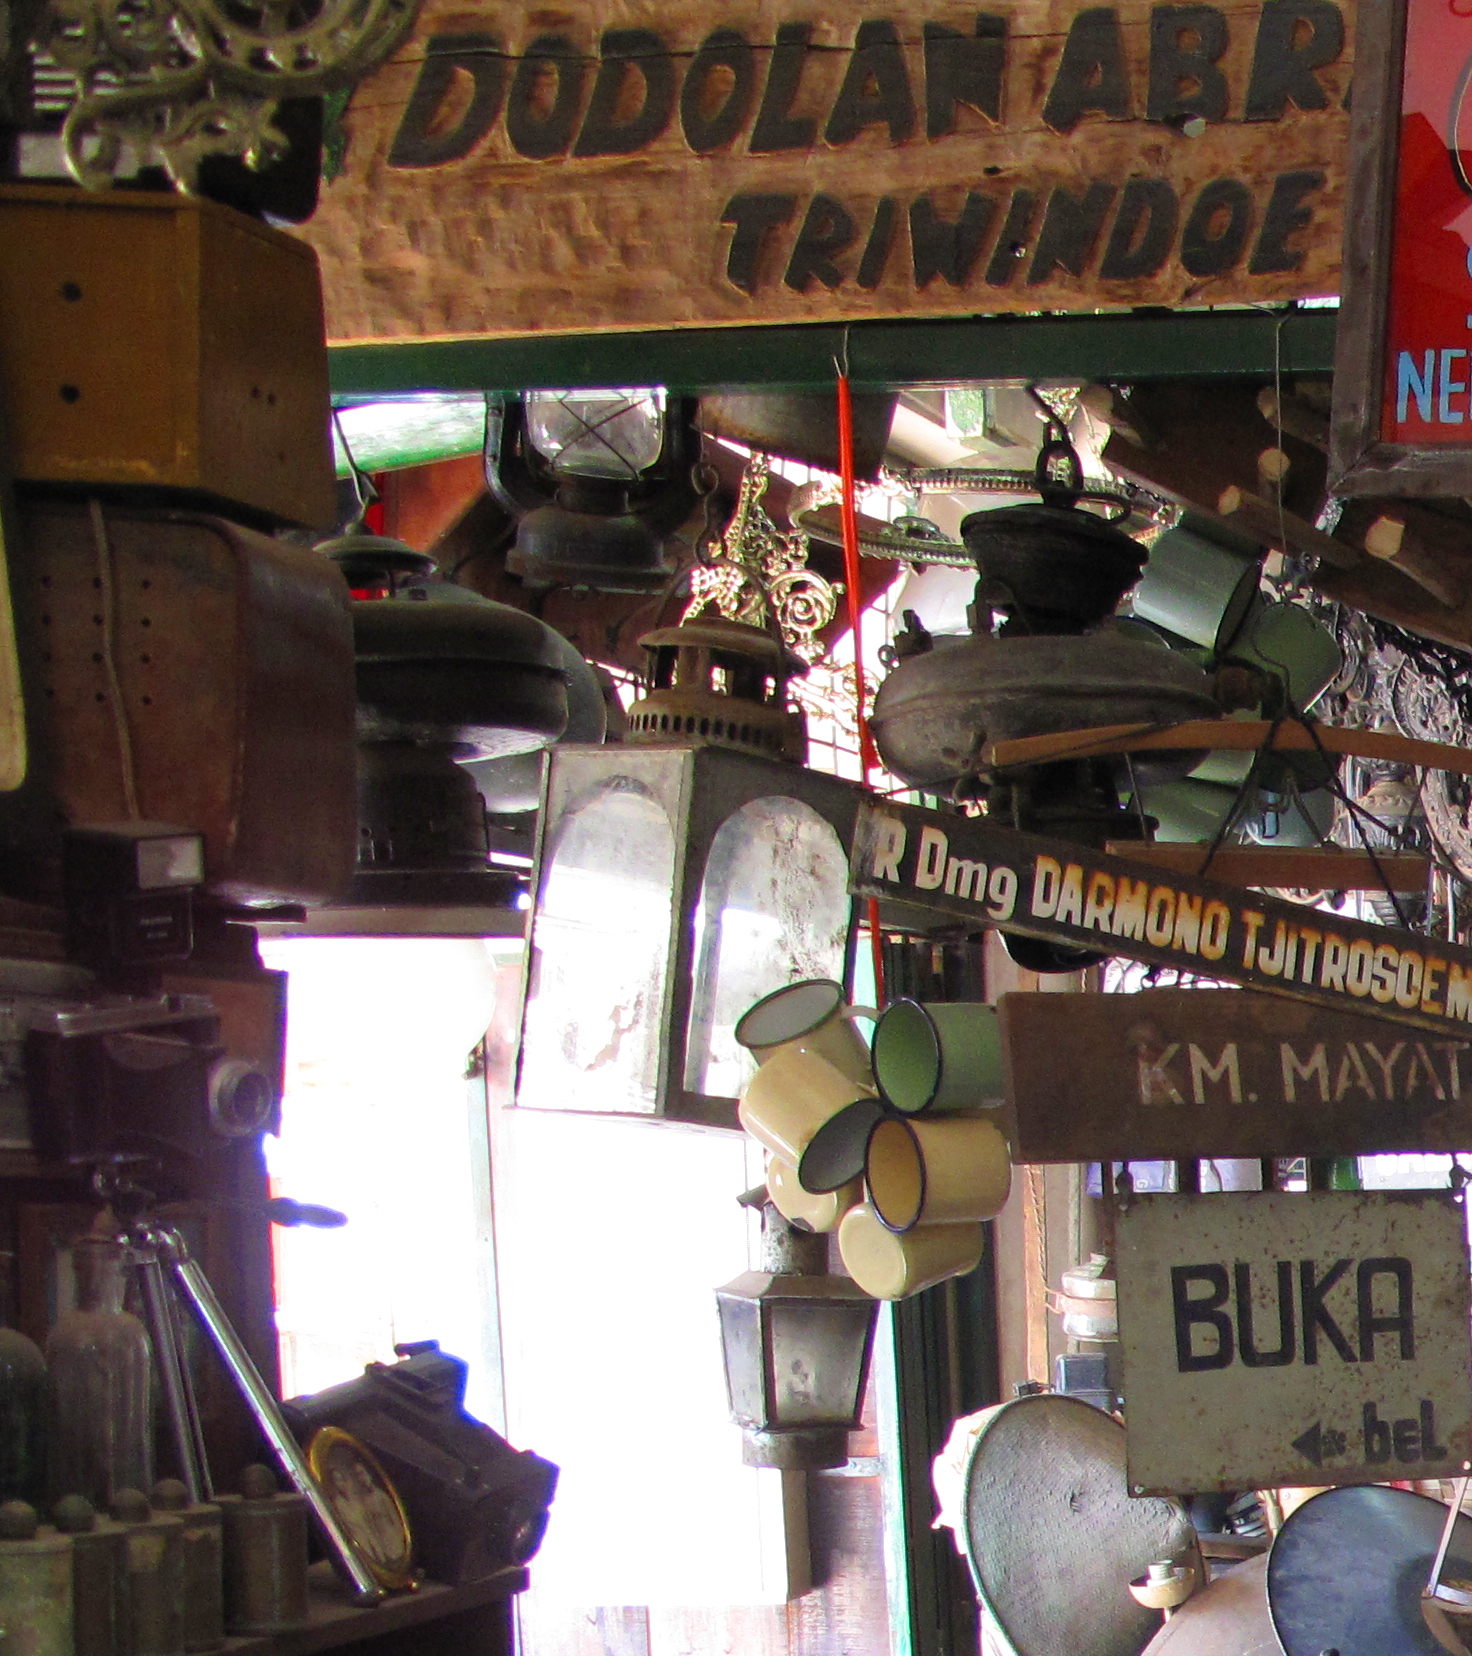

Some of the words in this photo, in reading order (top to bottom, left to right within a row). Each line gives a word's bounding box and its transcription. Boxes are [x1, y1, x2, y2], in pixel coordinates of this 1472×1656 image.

[386, 13, 1003, 168] DODOLAN
[1043, 1, 1352, 135] ABR
[719, 171, 1328, 295] TRIWINDOE
[872, 815, 907, 885] R
[914, 823, 1019, 921] Dmg
[1031, 853, 1232, 961] DARMONO
[1137, 1042, 1258, 1105] KM.
[1280, 1041, 1471, 1104] MAYAT
[1170, 1257, 1416, 1374] BUKA
